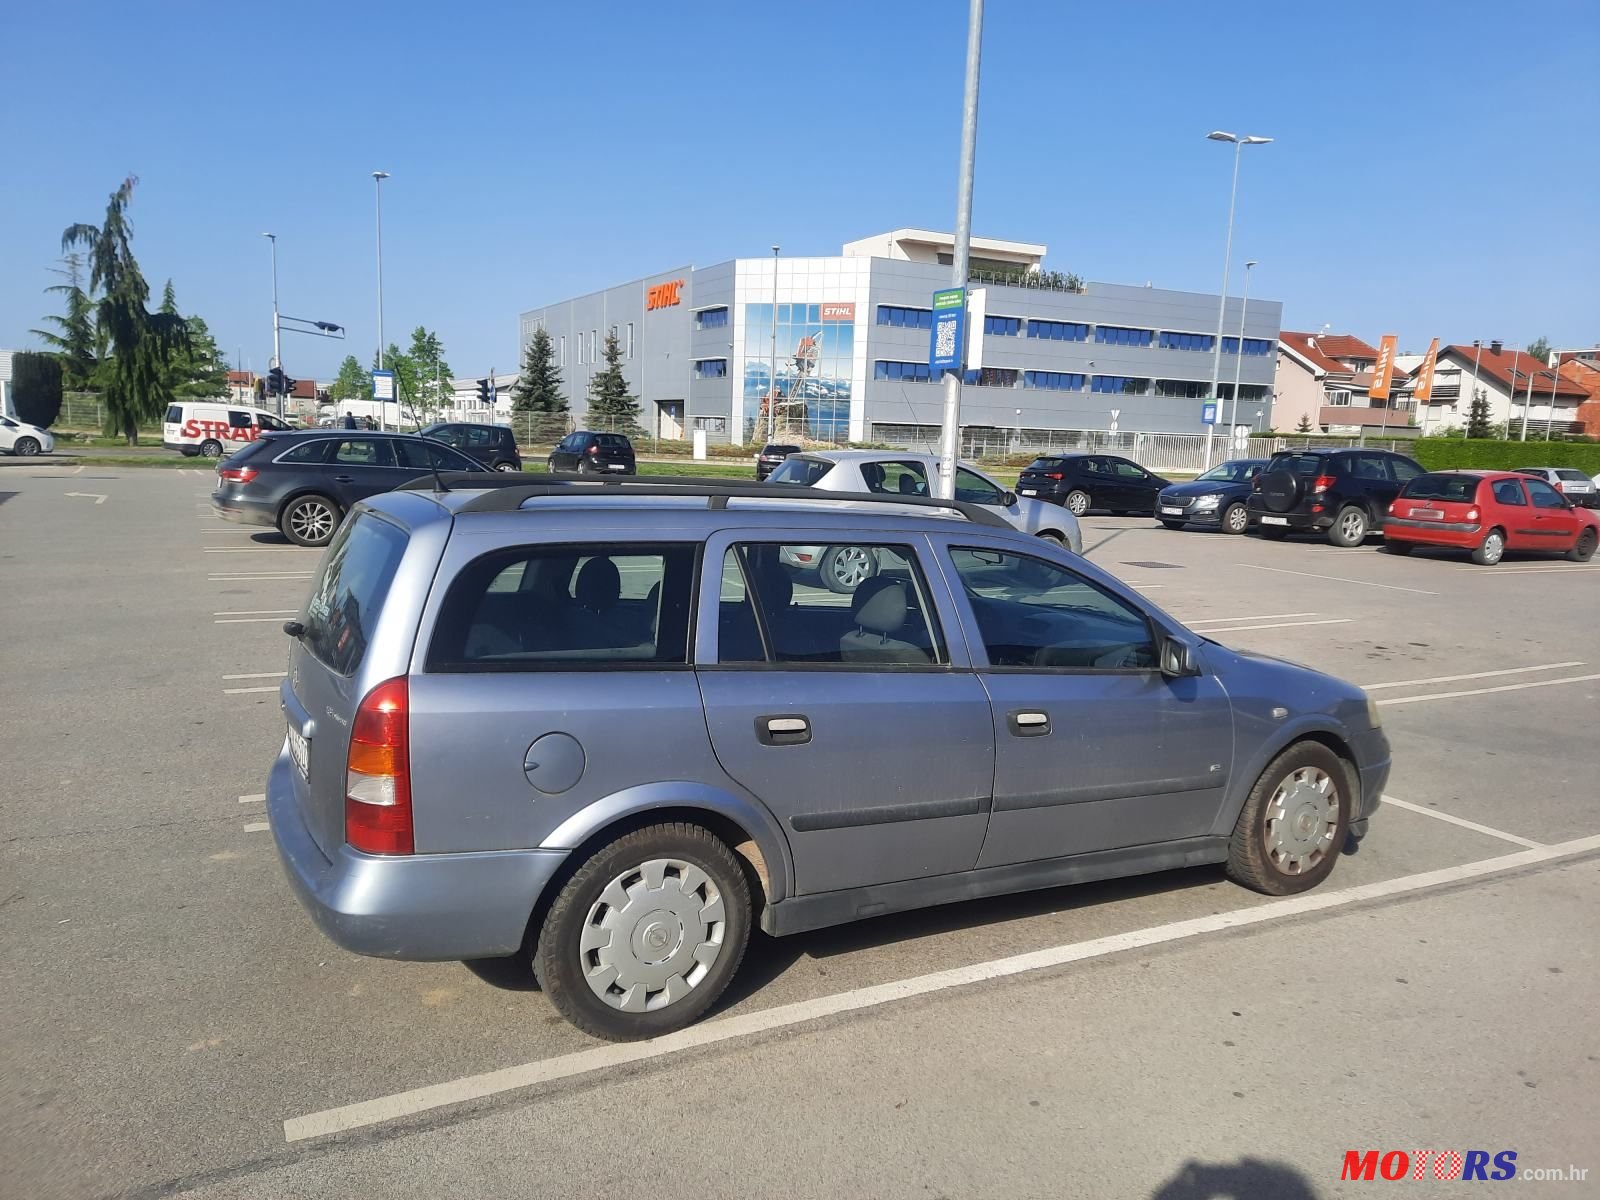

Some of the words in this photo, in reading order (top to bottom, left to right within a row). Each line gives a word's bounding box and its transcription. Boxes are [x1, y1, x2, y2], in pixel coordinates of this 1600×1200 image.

[647, 281, 682, 311] STIHL
[824, 307, 852, 316] STIHL
[1373, 342, 1390, 390] STIHL
